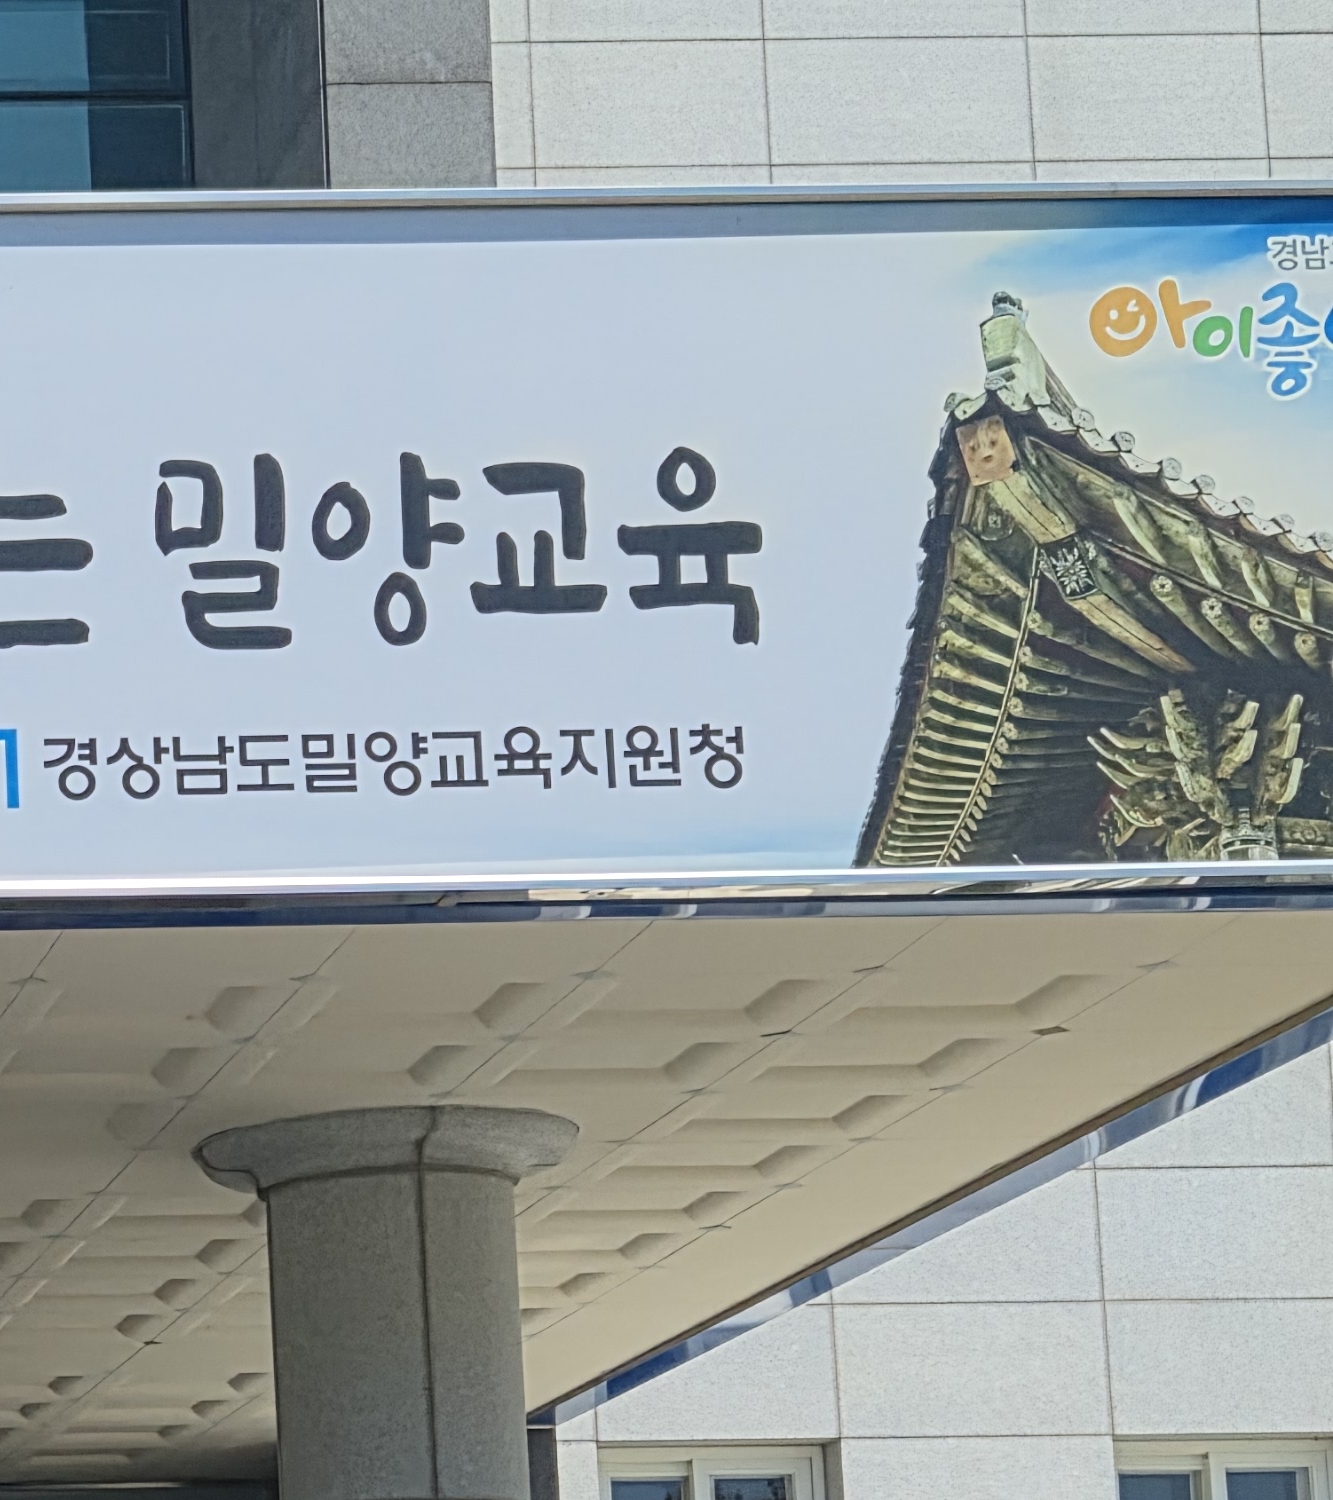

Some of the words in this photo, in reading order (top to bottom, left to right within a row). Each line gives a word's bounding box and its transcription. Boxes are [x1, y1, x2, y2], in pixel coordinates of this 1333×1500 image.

[1270, 238, 1333, 271] 경남
[1089, 279, 1333, 397] 아이좋
[154, 445, 763, 650] 밀양교육
[42, 722, 745, 802] 경상남도밀양교육지원청
